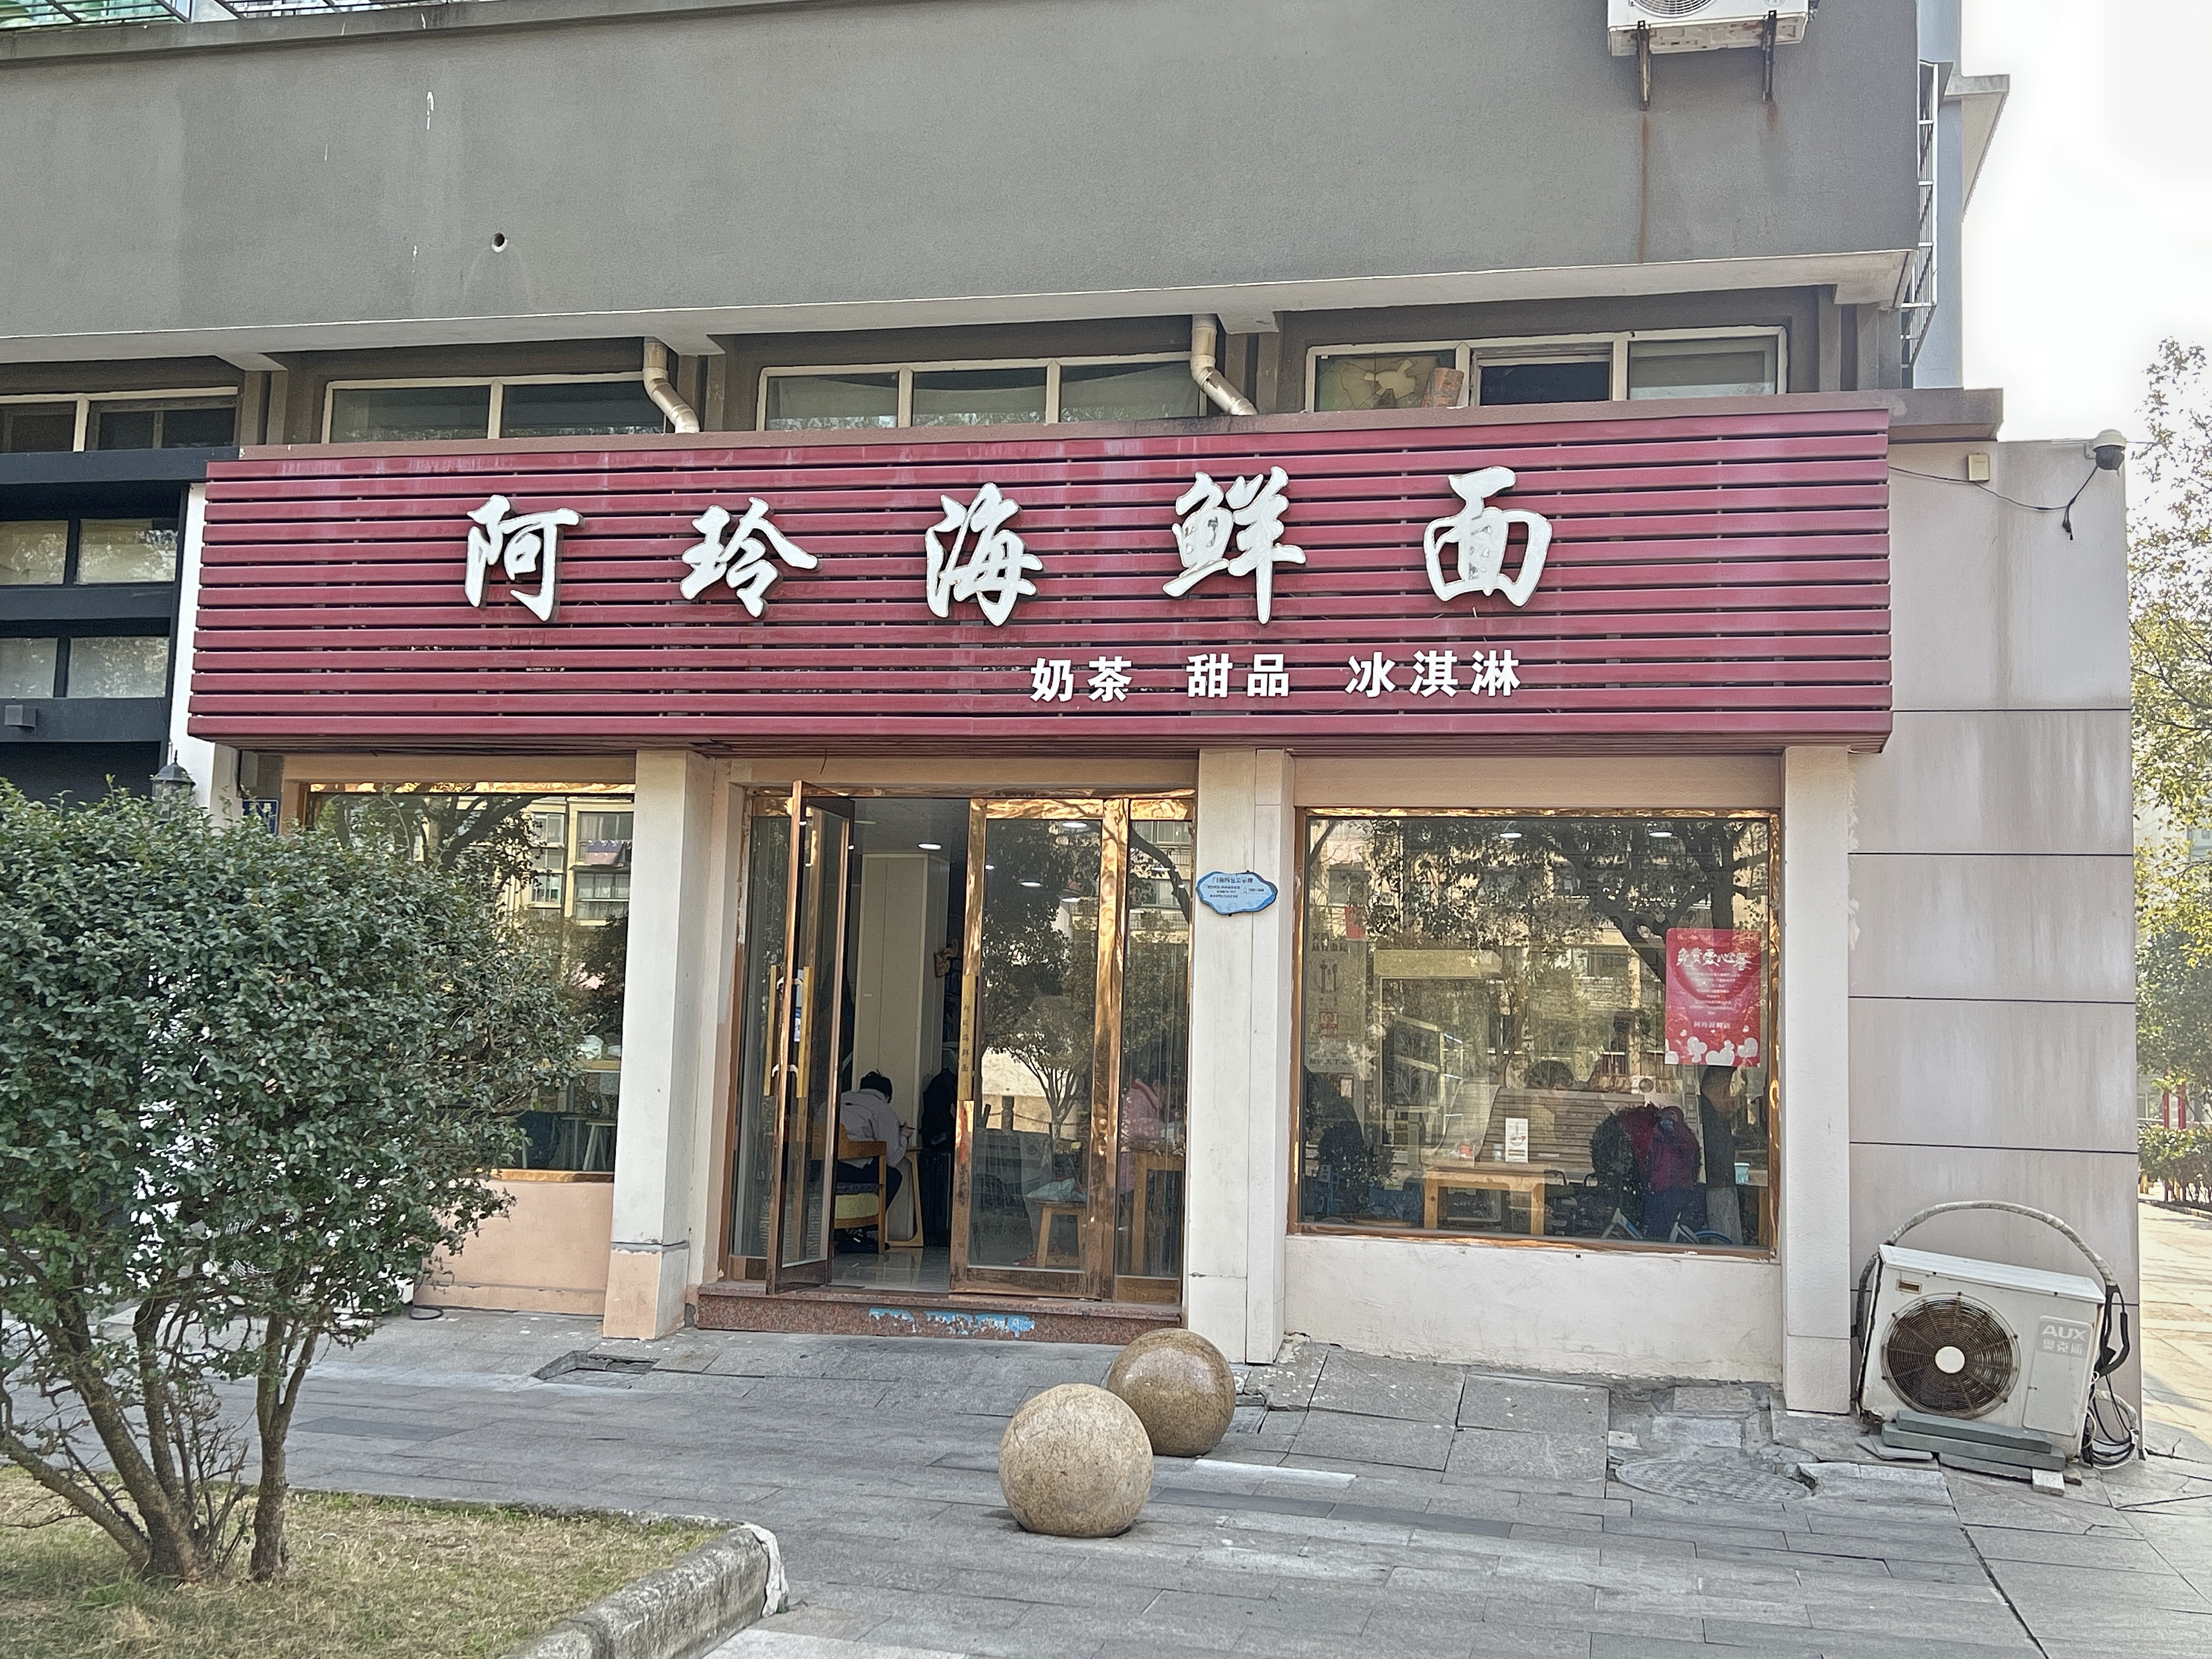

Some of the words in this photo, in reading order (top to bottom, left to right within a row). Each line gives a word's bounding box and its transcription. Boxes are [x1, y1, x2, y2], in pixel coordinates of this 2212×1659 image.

[466, 466, 1554, 627] 阿玲海鲜面
[1030, 656, 1133, 702] 奶茶
[1186, 652, 1291, 698] 甜品
[1345, 650, 1522, 698] 冰淇淋
[2042, 1325, 2087, 1341] AUX
[2044, 1339, 2083, 1355] 奥克斯
